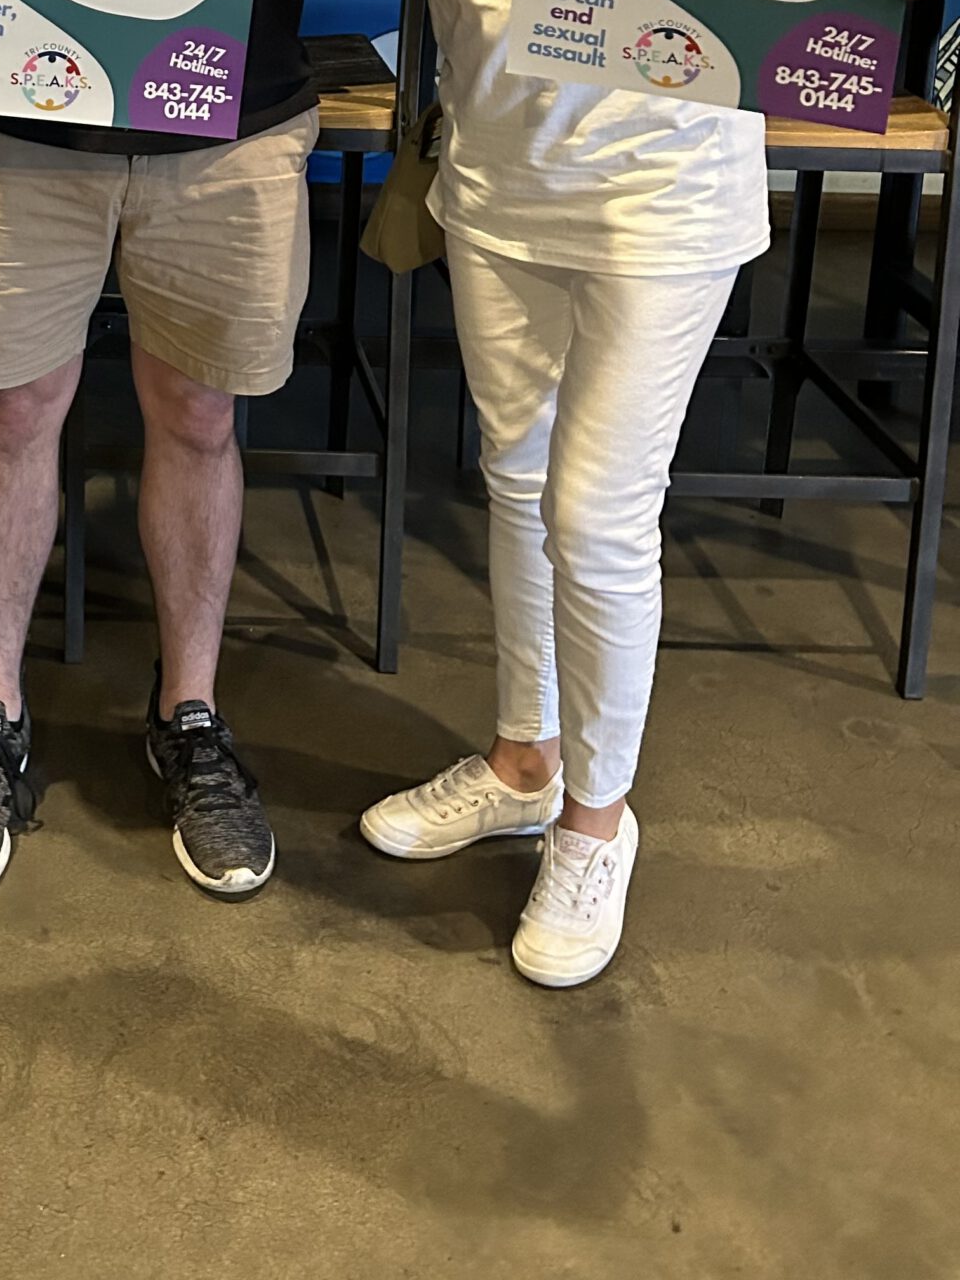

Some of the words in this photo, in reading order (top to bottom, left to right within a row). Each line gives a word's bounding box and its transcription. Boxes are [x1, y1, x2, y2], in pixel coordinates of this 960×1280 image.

[550, 6, 594, 25] end
[533, 23, 606, 48] sexual
[637, 19, 702, 39] TRI-COUNTY
[821, 26, 876, 51] 24/7
[24, 43, 82, 60] TRI-COUNTY
[182, 40, 227, 62] 24/7
[528, 42, 607, 68] assault
[806, 37, 878, 71] Hotline:
[169, 53, 229, 80] Hotline:
[143, 81, 233, 104] 843-745-
[775, 66, 883, 95] 843-745-
[164, 101, 211, 121] 0144
[799, 88, 855, 112] 0144
